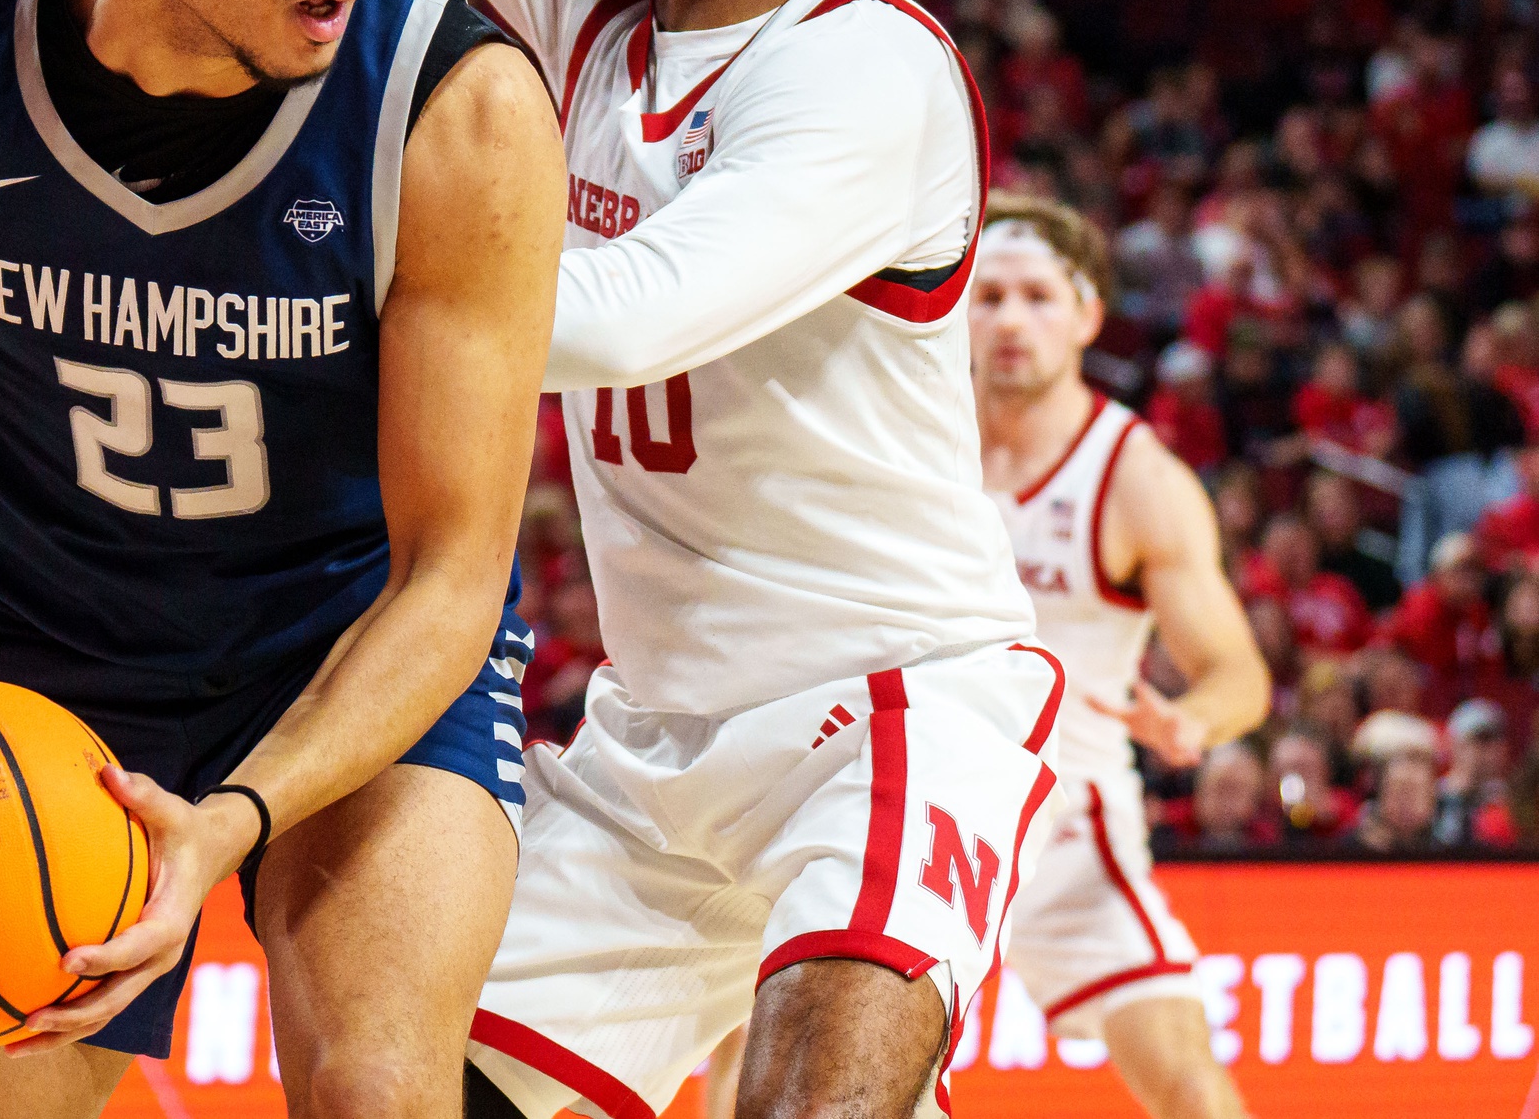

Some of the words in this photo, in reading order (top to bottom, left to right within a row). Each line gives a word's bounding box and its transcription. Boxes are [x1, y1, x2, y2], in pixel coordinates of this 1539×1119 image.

[284, 209, 343, 225] AMERICA
[297, 221, 329, 231] EAST
[567, 173, 651, 239] NEBR
[83, 273, 351, 360] HAMPSHIRE
[53, 355, 272, 520] 23
[918, 801, 1002, 949] N
